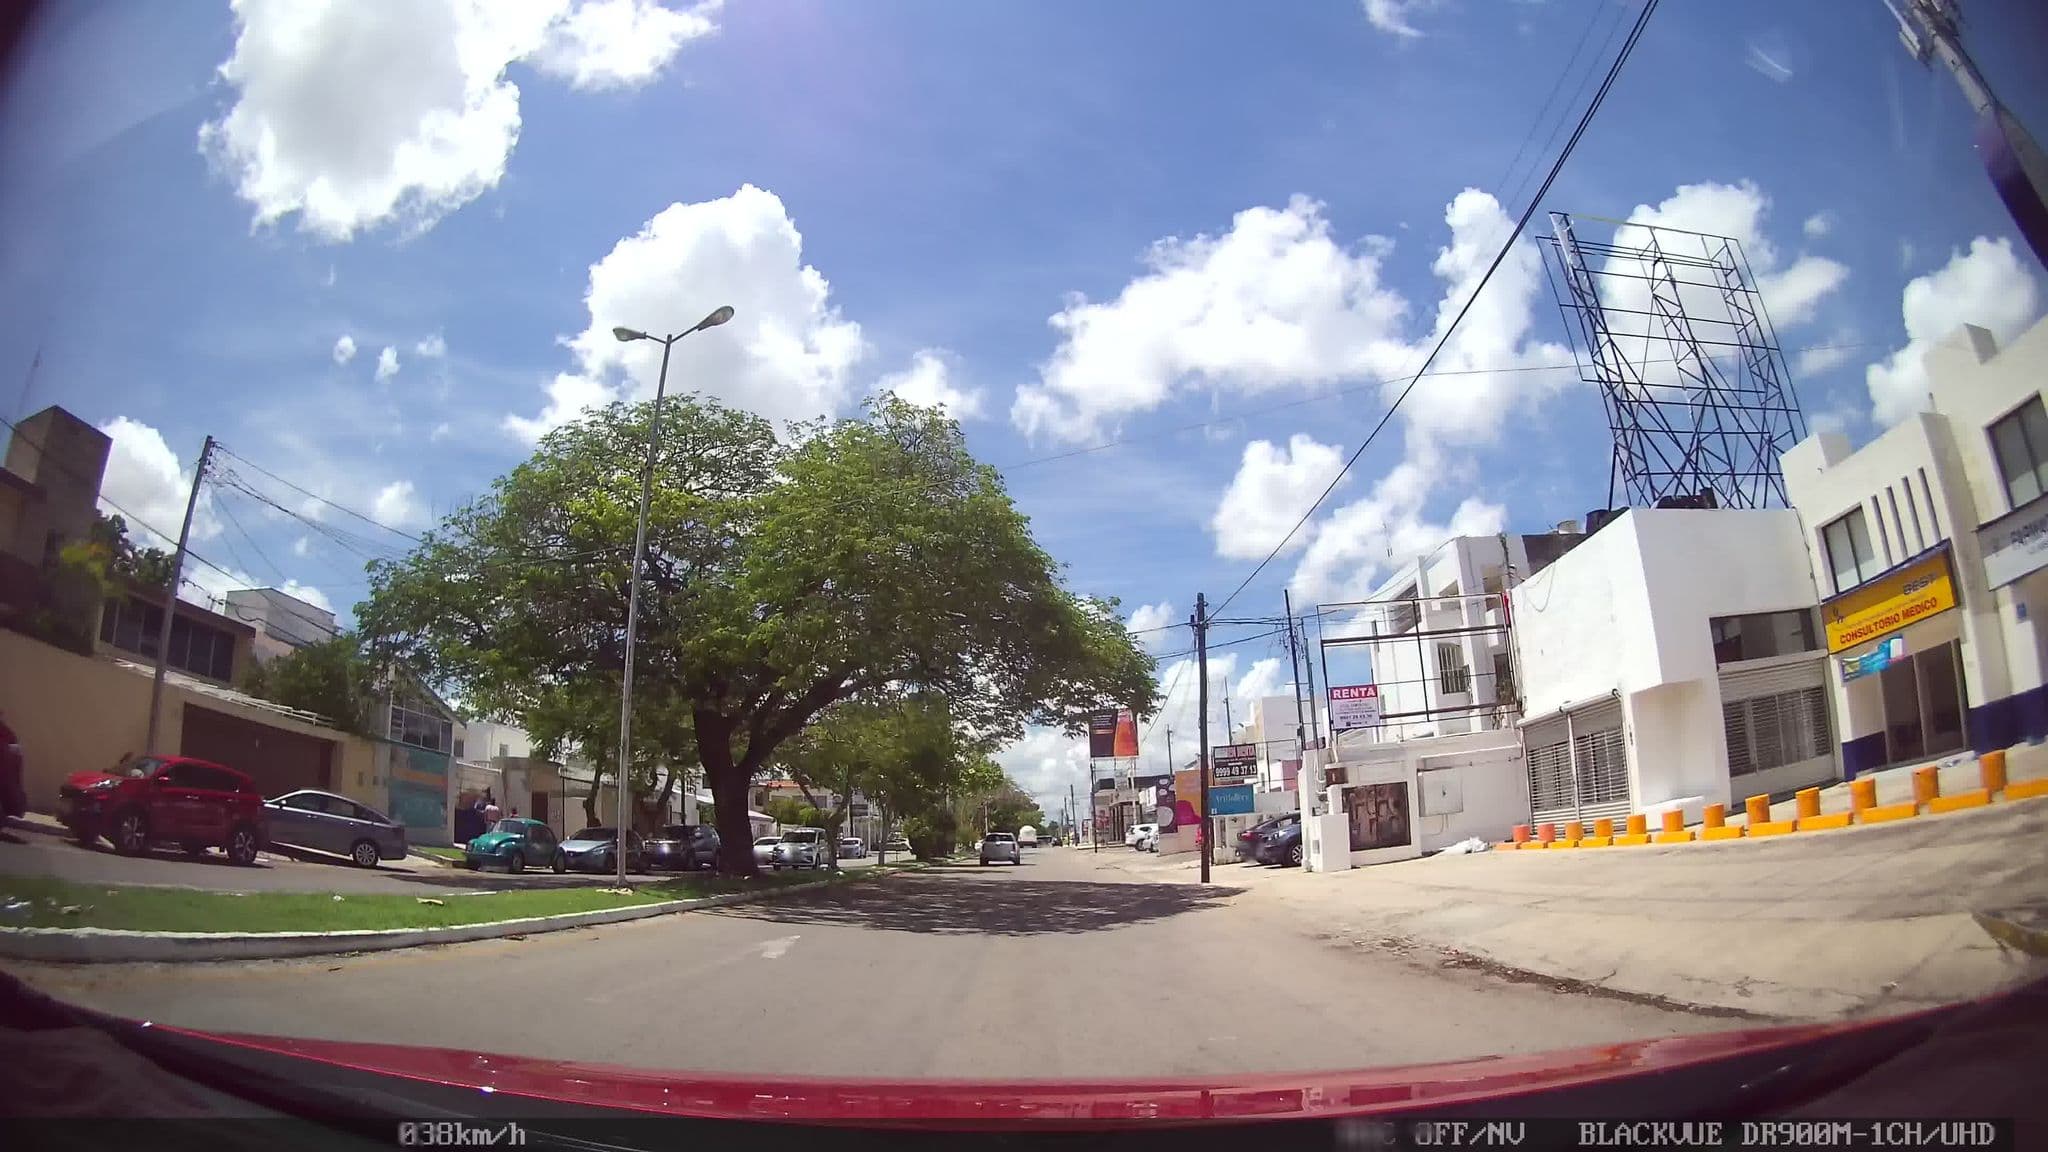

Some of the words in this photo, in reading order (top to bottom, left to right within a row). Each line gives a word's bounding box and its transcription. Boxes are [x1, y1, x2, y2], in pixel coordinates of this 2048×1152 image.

[1840, 613, 1900, 644] CONSULTORIO
[1901, 597, 1938, 621] MEDICO
[1333, 687, 1376, 699] RENTA
